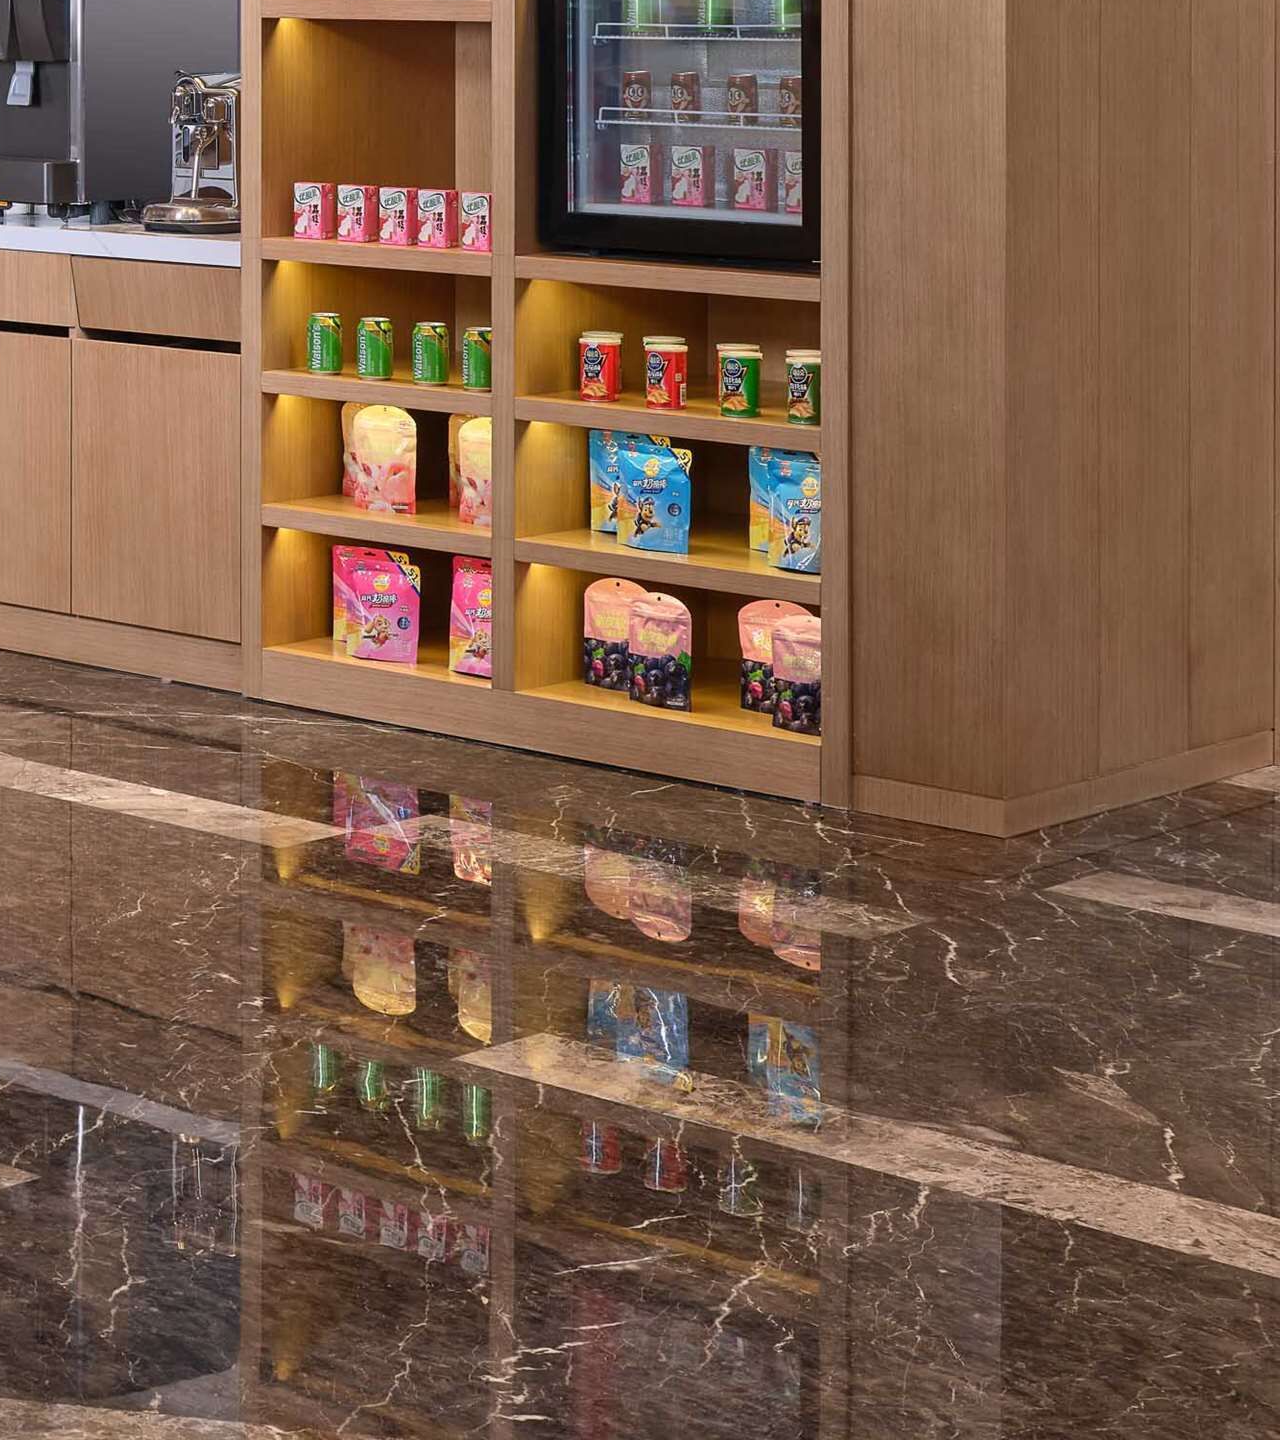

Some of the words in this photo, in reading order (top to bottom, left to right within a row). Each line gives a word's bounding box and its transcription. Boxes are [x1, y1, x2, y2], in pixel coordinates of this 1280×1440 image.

[312, 323, 320, 369] Watson's
[358, 329, 366, 374] Watson's
[414, 334, 424, 379] Watson's
